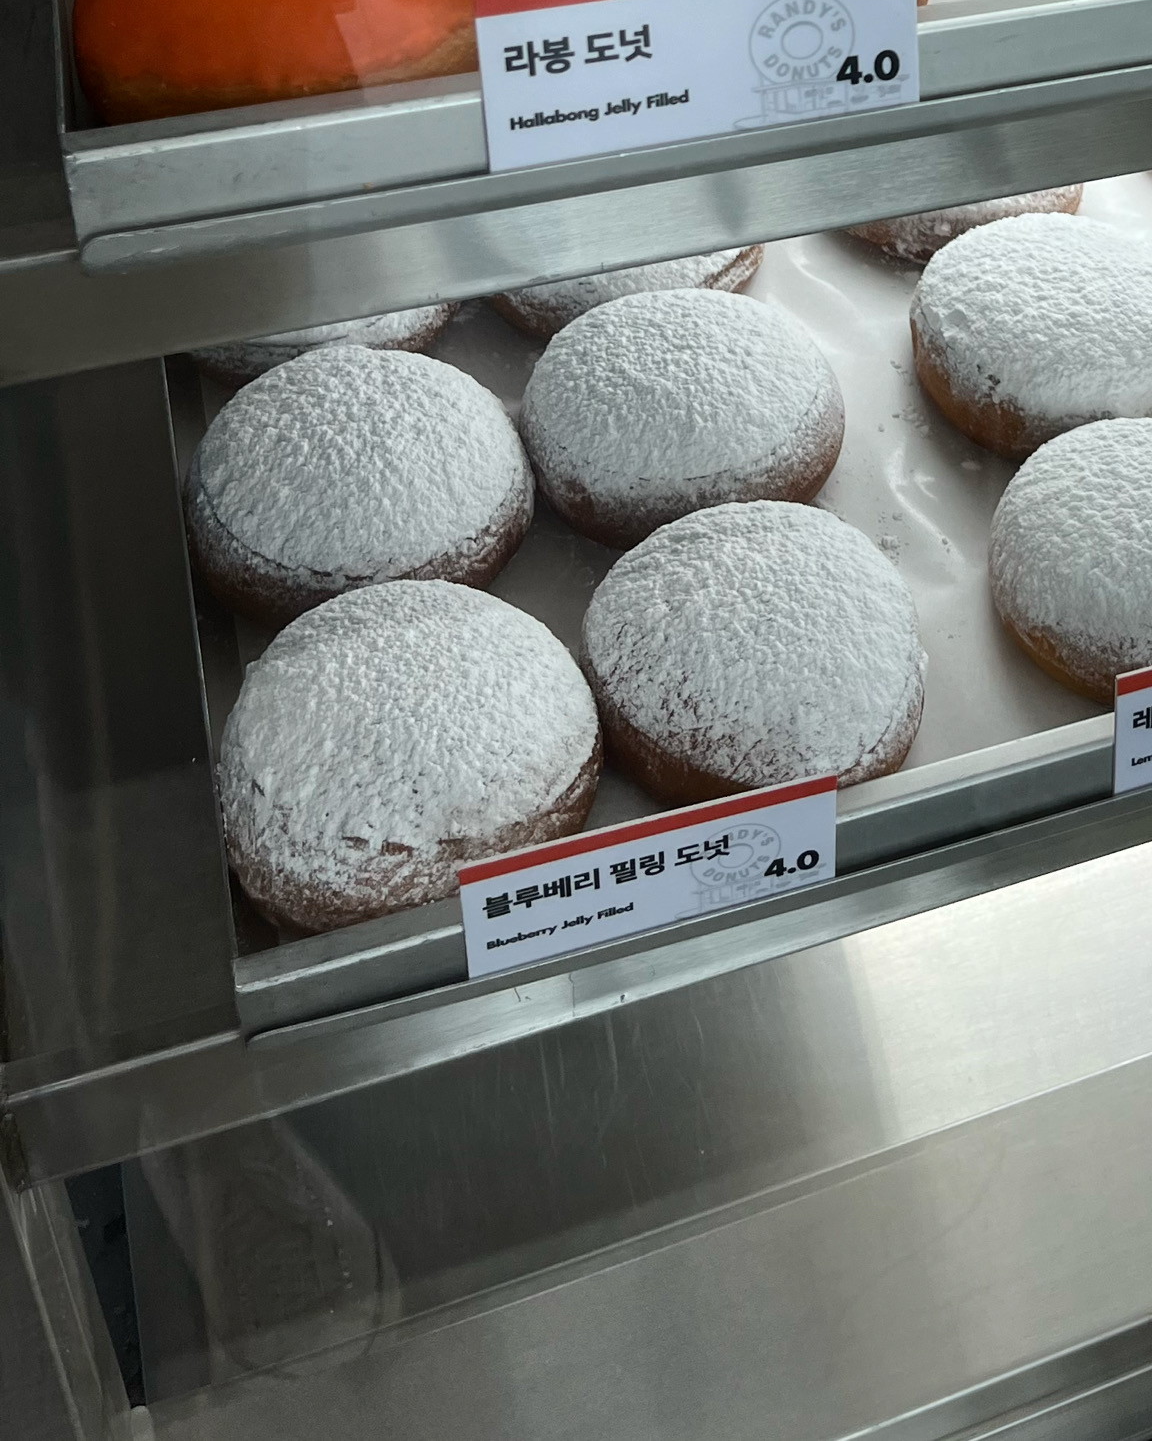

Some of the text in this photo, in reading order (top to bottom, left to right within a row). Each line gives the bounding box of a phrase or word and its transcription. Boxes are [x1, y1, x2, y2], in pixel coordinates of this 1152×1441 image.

[758, 0, 847, 39] RANDY'S
[504, 24, 653, 77] 라봉 도넛
[763, 46, 842, 82] DONUTS
[836, 50, 900, 85] 4.0
[510, 90, 690, 131] Hallabong Jelly Filled
[482, 834, 730, 919] 블루베리 필링 도넛
[702, 855, 770, 883] DONUTS
[764, 850, 819, 877] 4.0
[487, 902, 634, 950] Blueberry Jelly Filled
